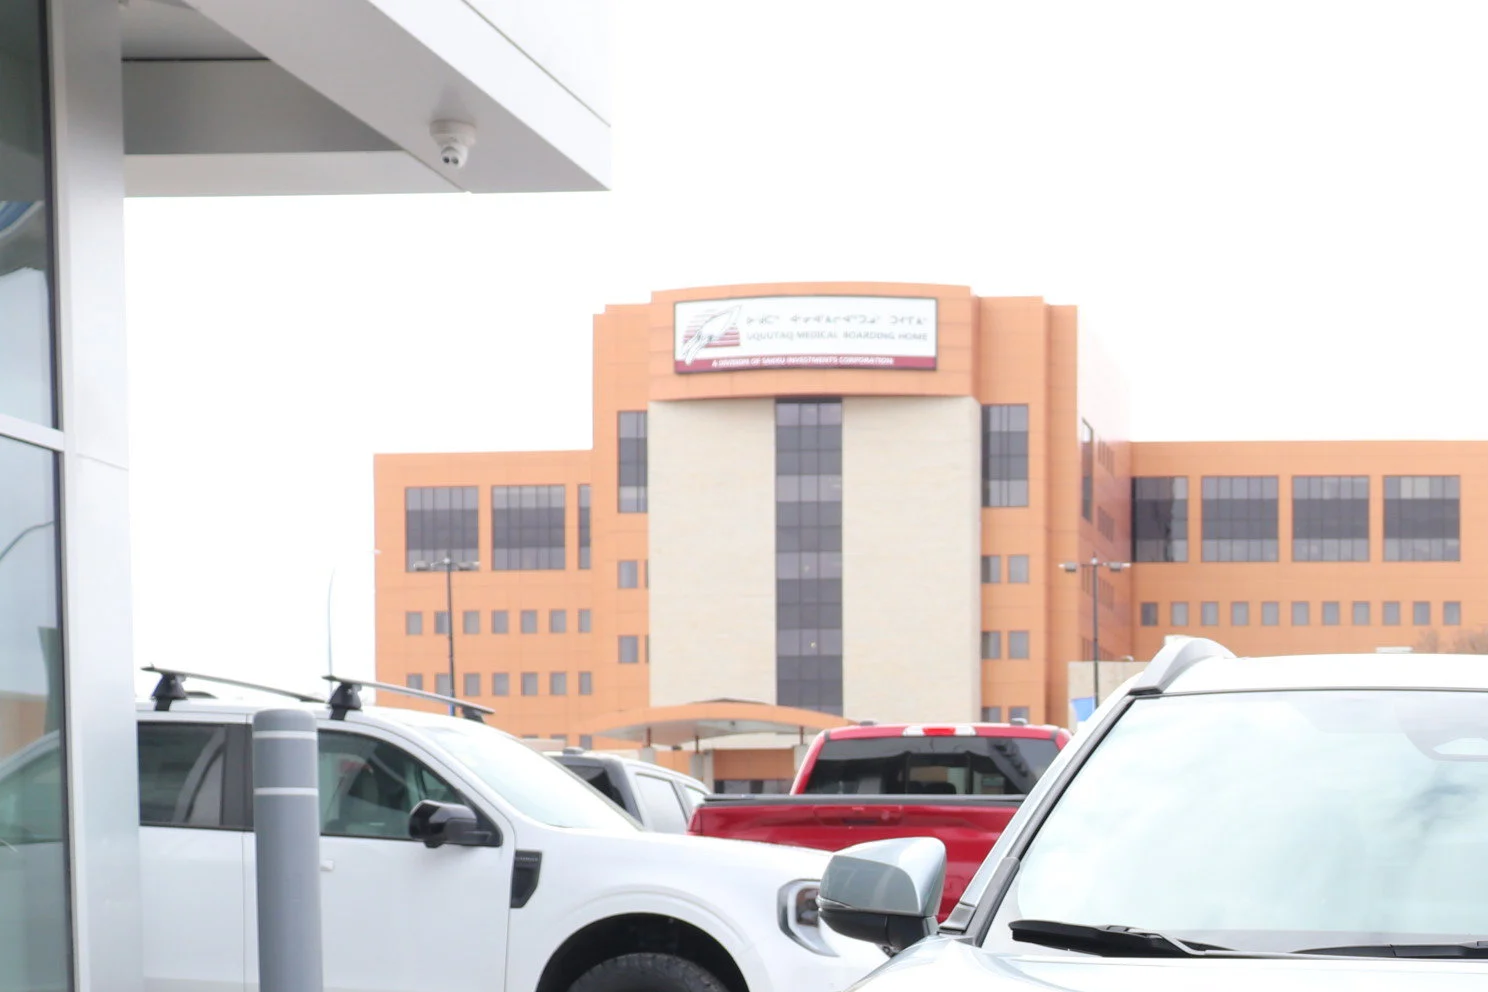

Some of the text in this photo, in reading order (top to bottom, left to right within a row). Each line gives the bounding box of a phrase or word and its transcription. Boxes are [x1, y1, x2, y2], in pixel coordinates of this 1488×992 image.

[796, 331, 838, 341] MEDICAL
[842, 331, 895, 341] BOARDING
[898, 332, 929, 342] HOME
[750, 357, 760, 366] OF
